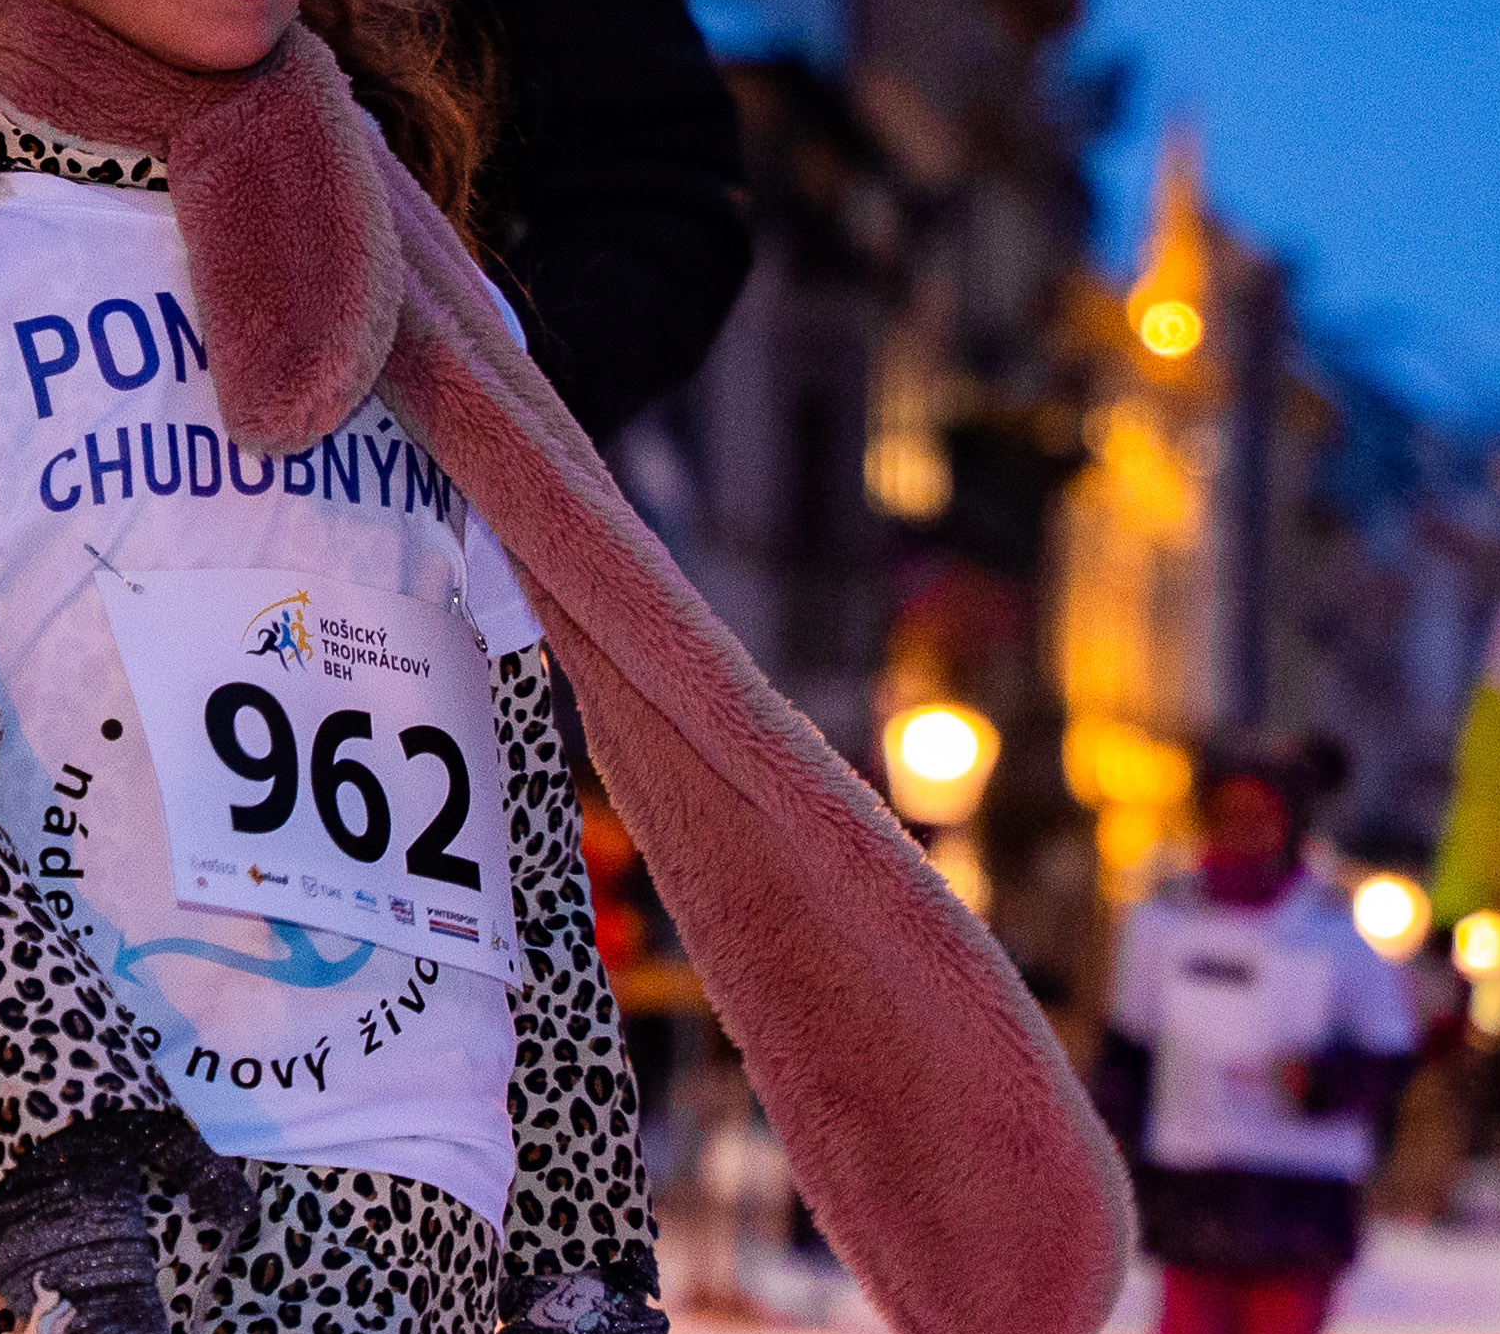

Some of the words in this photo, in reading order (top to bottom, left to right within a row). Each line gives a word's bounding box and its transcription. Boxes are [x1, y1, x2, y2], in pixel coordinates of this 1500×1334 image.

[320, 618, 387, 647] KOŠICKÝ
[321, 638, 431, 679] TROJKRÁĽOVÝ
[323, 659, 353, 681] BEH
[204, 681, 482, 893] 962
[185, 1036, 332, 1093] nový
